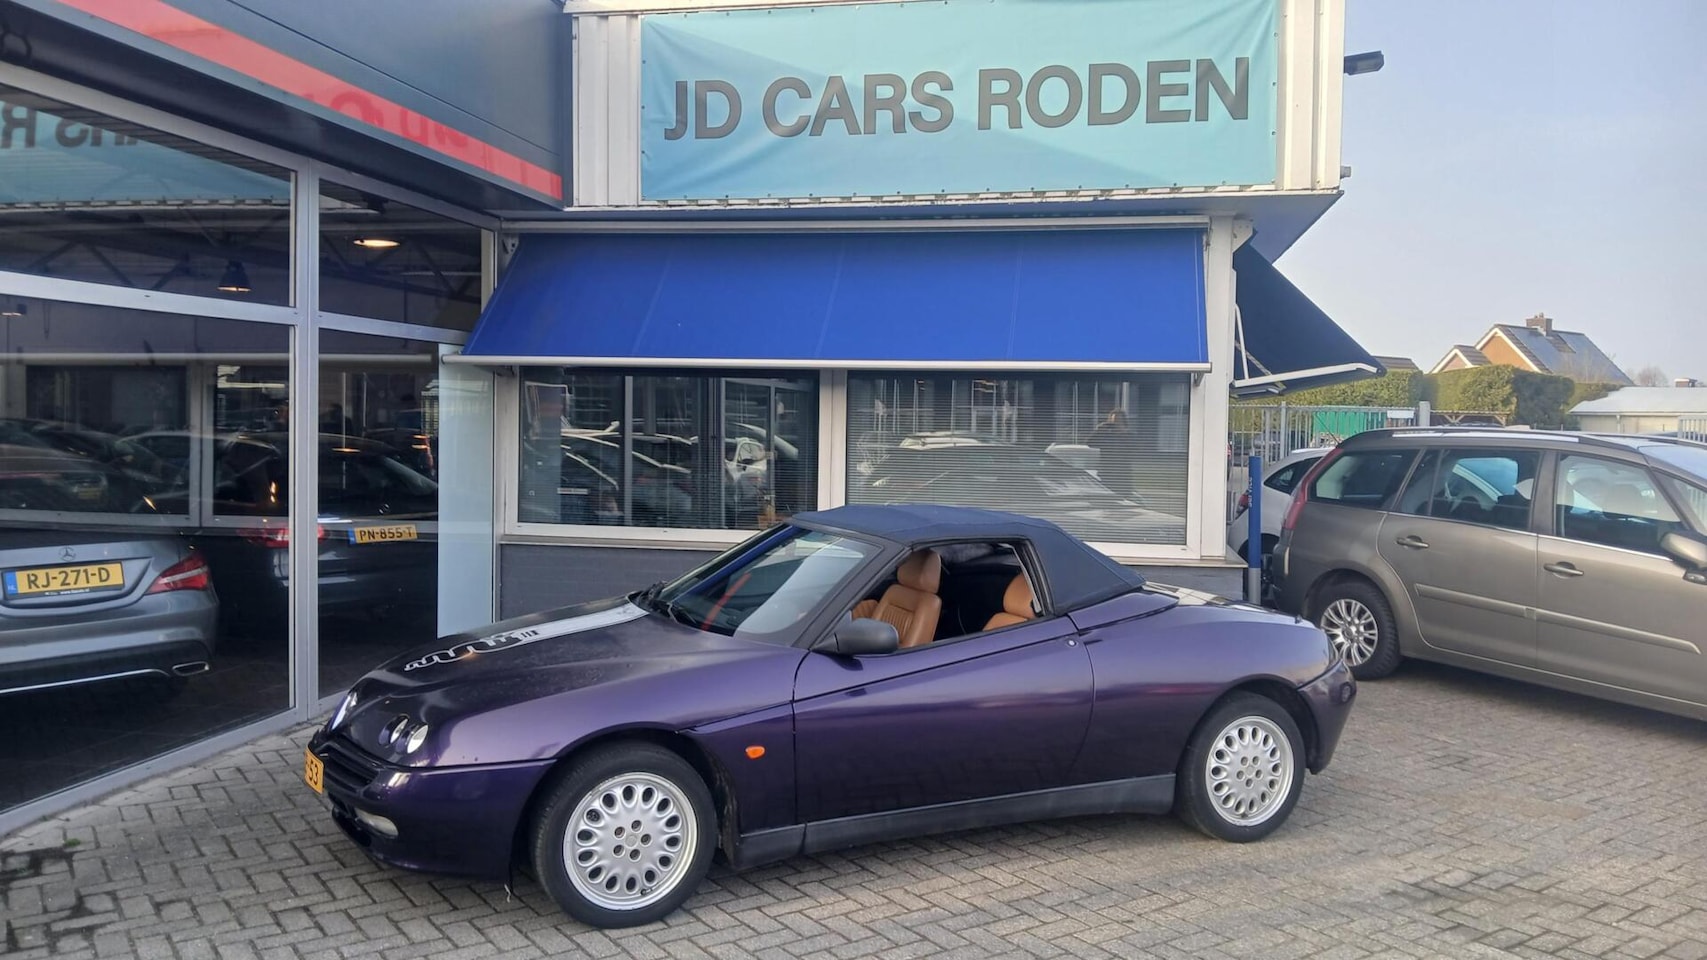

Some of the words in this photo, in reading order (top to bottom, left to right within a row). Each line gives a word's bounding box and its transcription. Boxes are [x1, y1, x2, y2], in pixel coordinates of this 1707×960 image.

[664, 79, 742, 140] JD
[762, 71, 954, 138] CARS
[977, 57, 1249, 130] RODEN
[359, 526, 413, 541] PN-855-T
[26, 567, 111, 589] RJ-271-D
